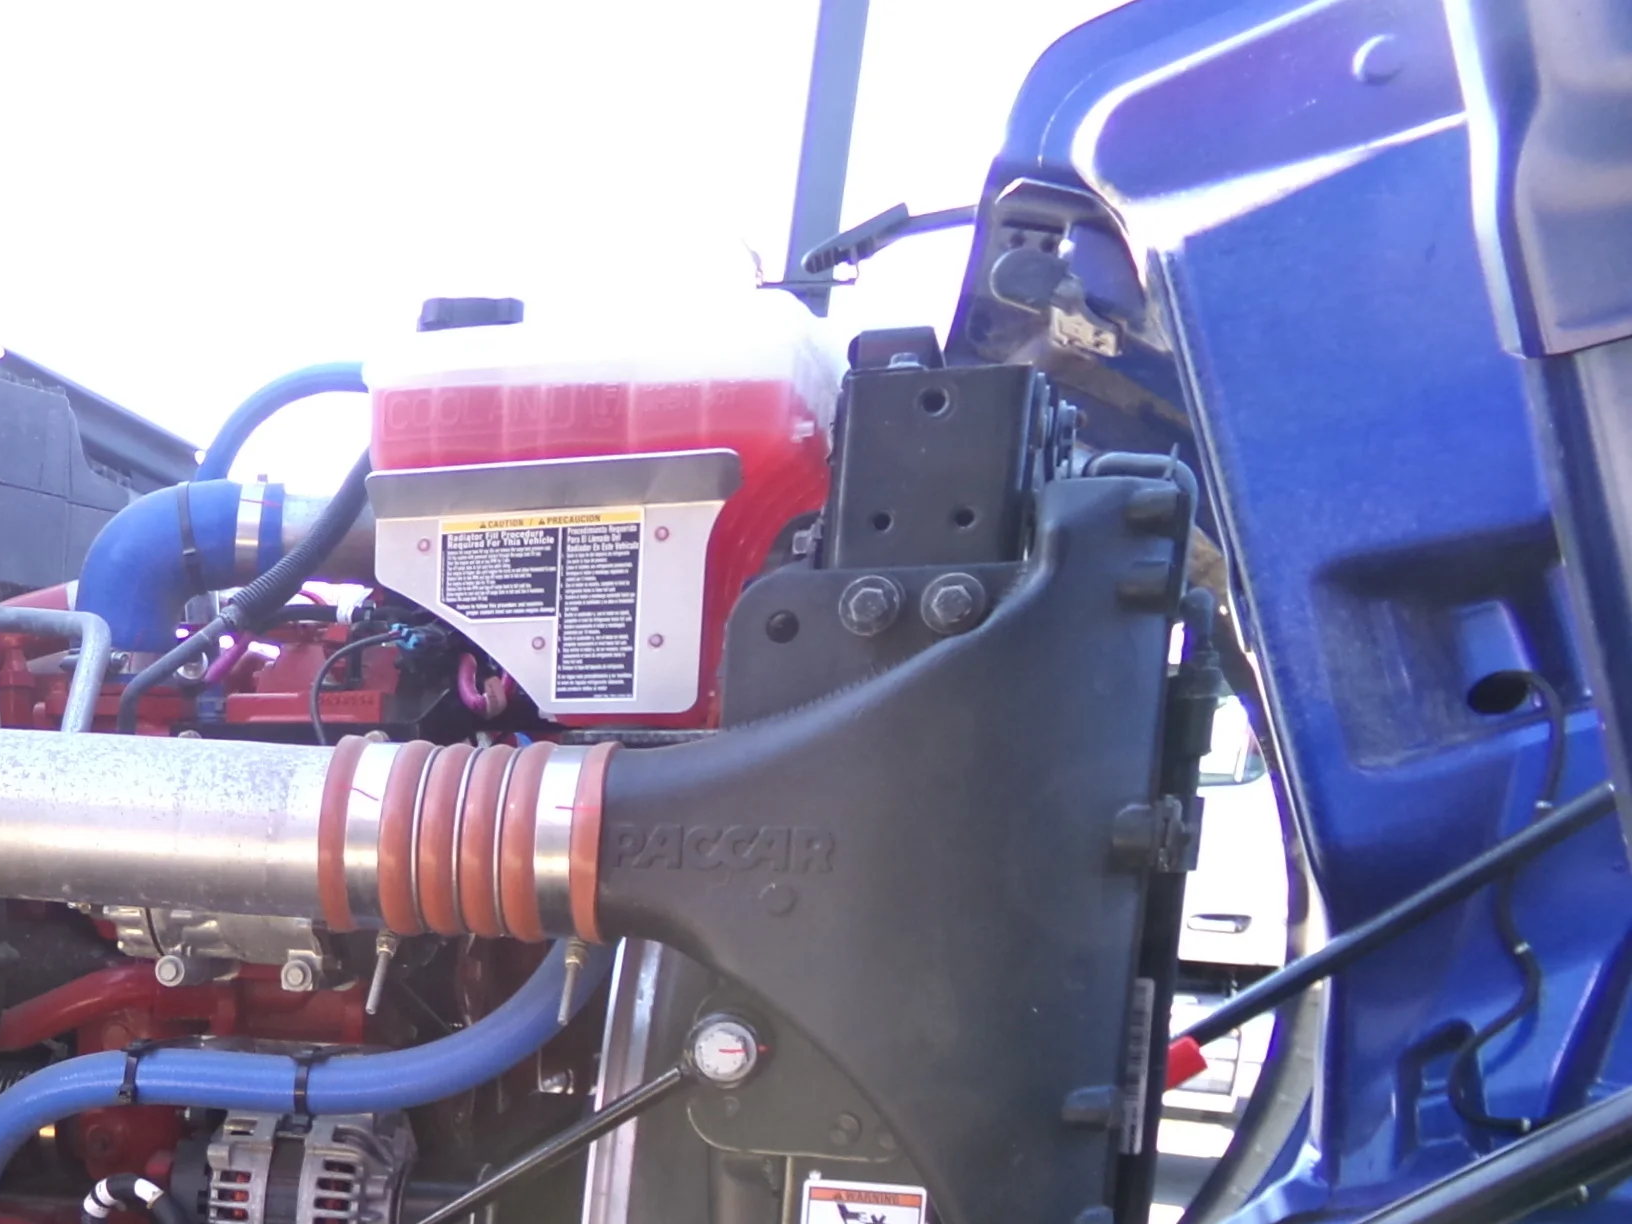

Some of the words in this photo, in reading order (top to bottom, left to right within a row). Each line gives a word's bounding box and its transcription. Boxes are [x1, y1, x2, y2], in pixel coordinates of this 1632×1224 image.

[487, 519, 524, 529] CAUTION
[447, 540, 485, 550] Required
[523, 536, 555, 545] Vehicle
[448, 533, 483, 542] Radiator
[501, 530, 544, 539] Procedure
[611, 824, 836, 874] PACCAR
[845, 1191, 899, 1205] WARNING
